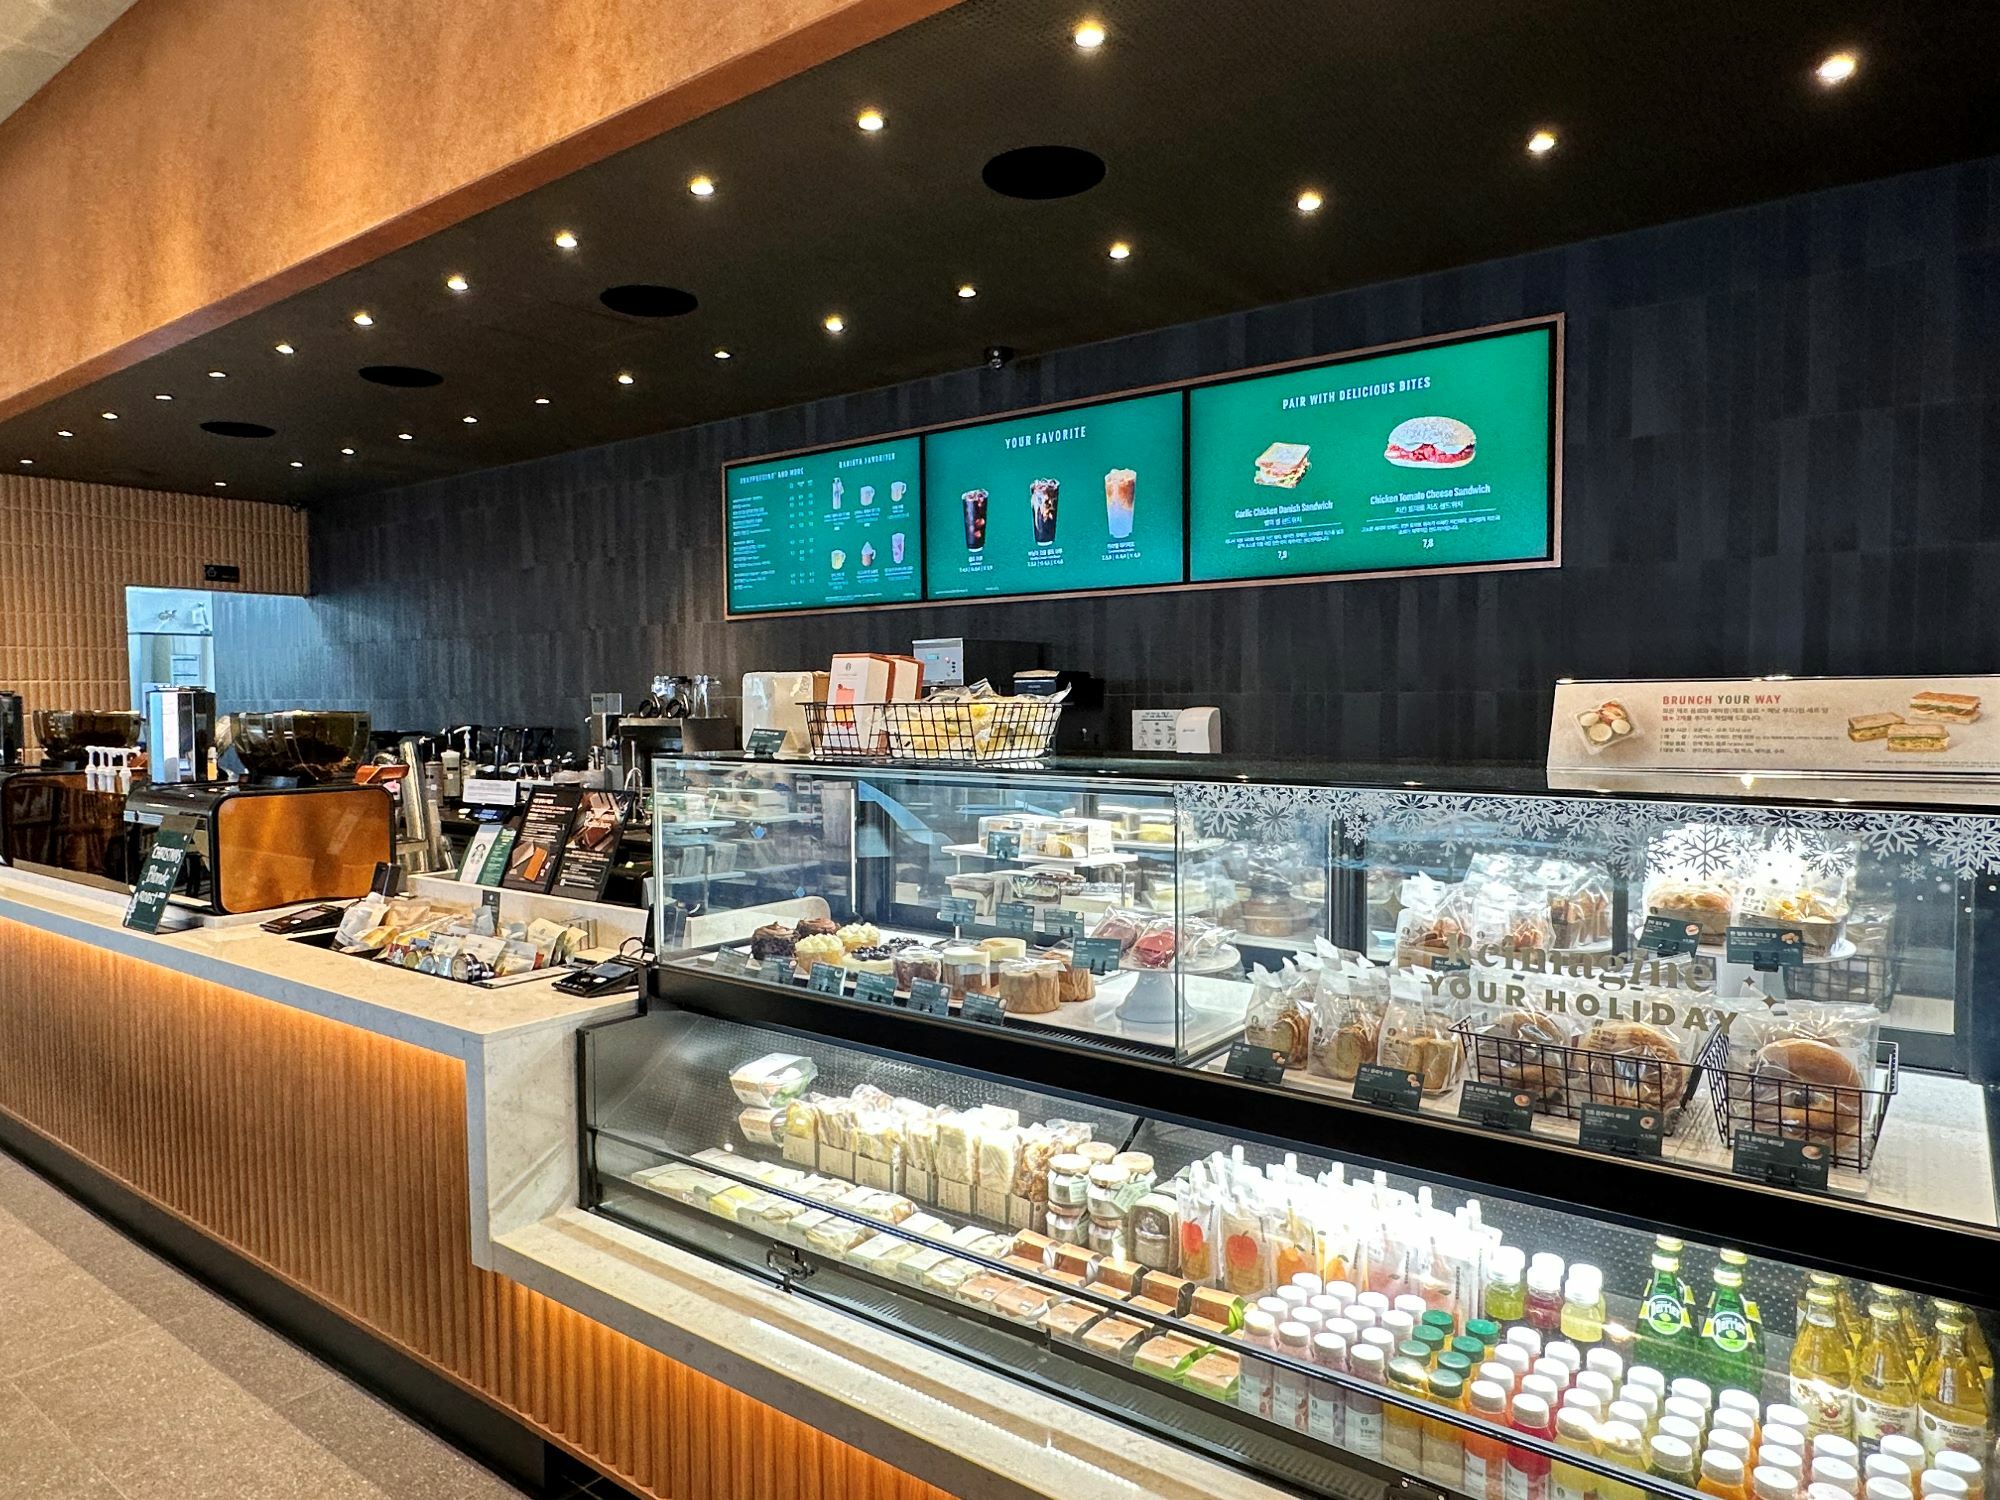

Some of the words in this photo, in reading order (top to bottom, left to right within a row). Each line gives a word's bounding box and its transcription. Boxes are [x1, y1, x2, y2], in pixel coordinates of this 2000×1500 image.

[1282, 395, 1306, 410] PAIR
[1310, 391, 1336, 406] WITH
[1339, 382, 1396, 402] DELICIOUS
[1399, 376, 1431, 392] BITES
[1004, 435, 1031, 450] YOUR
[1036, 425, 1087, 445] FAVORITE
[1370, 494, 1398, 505] Chicken
[1398, 492, 1425, 503] Tomato
[1426, 489, 1454, 500] Cheese
[1454, 484, 1491, 496] Sandwich
[1234, 509, 1253, 518] Garlic
[1253, 506, 1278, 517] Chicken
[1278, 504, 1301, 514] Danish
[1301, 500, 1334, 512] Sandwich
[1662, 695, 1713, 705] BRUNCH
[1717, 695, 1750, 705] YOUR
[1754, 694, 1782, 704] WAY
[1447, 933, 1713, 993] Reimagine
[1426, 974, 1527, 1007] YOUR
[1545, 989, 1739, 1035] HOLIDAY
[1650, 1301, 1680, 1317] Perrier
[1715, 1318, 1746, 1335] Perrier
